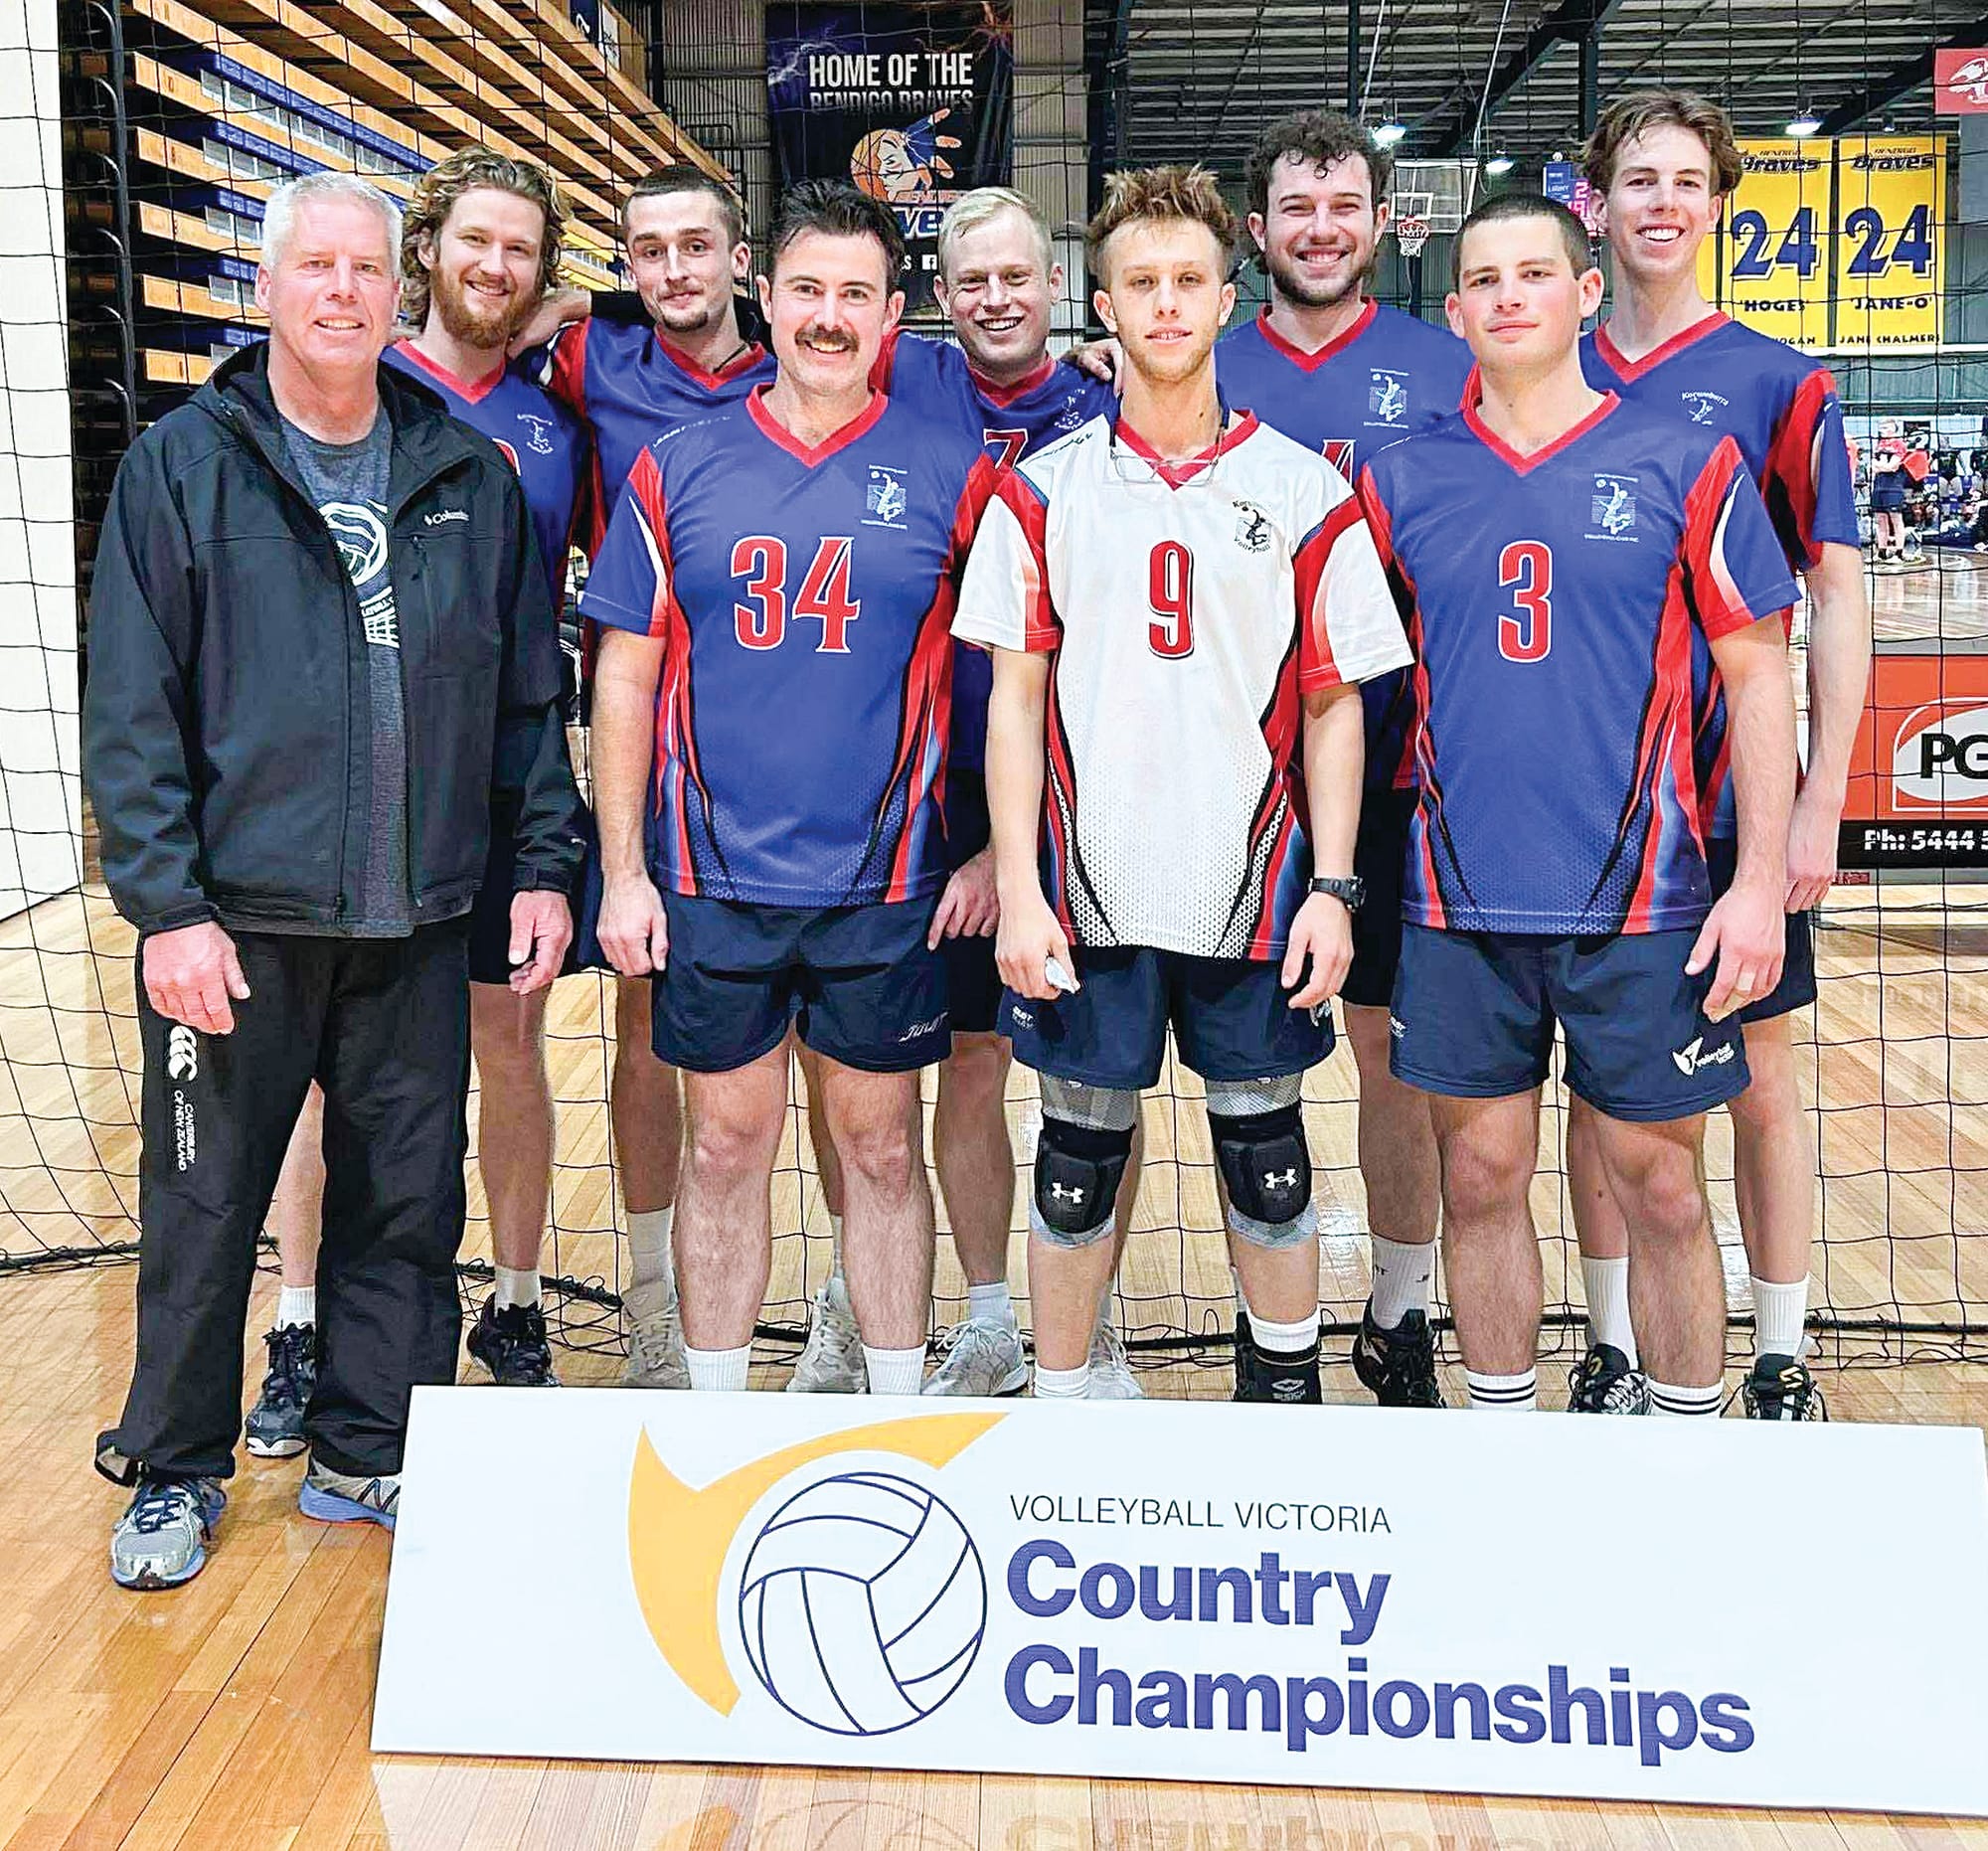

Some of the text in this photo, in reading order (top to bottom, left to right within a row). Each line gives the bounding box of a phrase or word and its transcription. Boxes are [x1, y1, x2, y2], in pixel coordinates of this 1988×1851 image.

[809, 53, 974, 87] HOME OF THE
[1730, 206, 1822, 280] 24
[1844, 204, 1936, 279] 24
[731, 535, 862, 654] 34
[1147, 539, 1195, 661] 9
[1497, 539, 1553, 664] 3
[1910, 829, 1976, 851] 5444
[1010, 1494, 1392, 1534] VOLLEYBALL VICTORIA
[1007, 1539, 1392, 1645] Country
[1004, 1643, 1755, 1767] Championships
